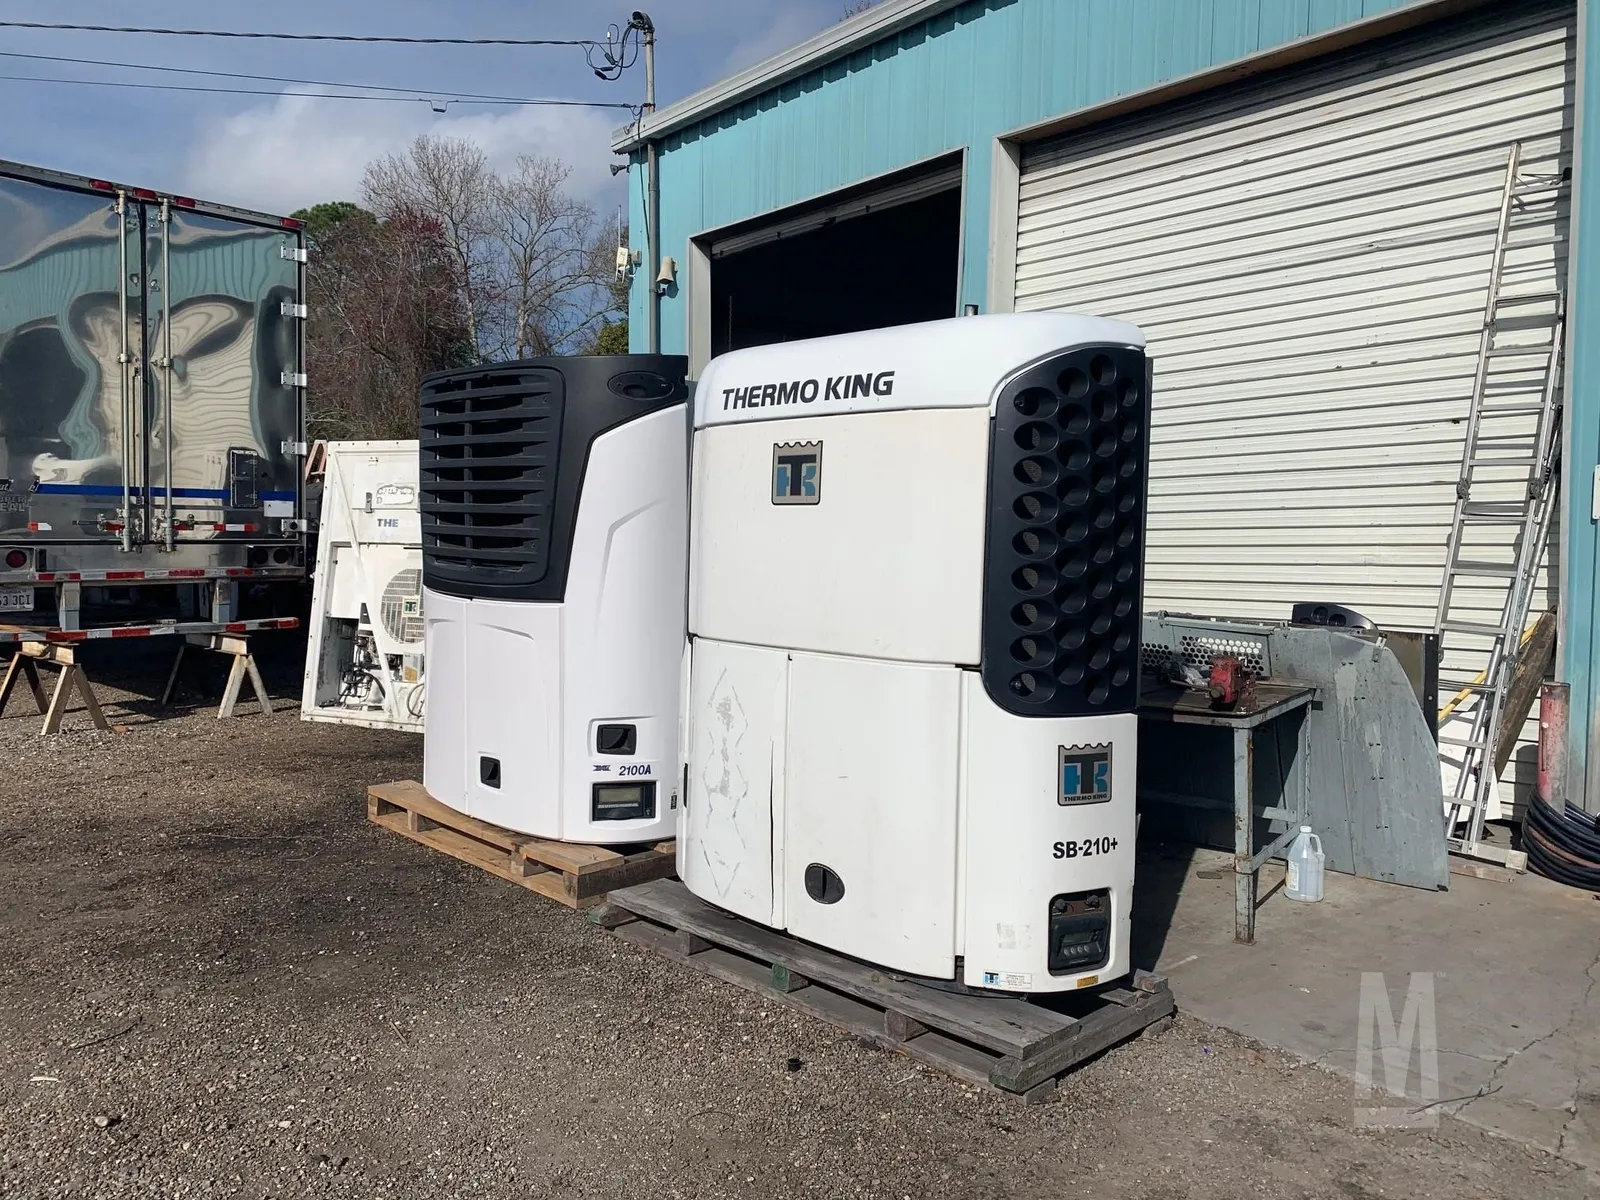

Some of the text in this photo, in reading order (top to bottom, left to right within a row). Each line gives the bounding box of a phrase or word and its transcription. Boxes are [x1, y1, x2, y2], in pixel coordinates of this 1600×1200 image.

[723, 371, 895, 410] THERMO KING
[0, 595, 9, 606] 3
[618, 764, 652, 776] 2100A
[1052, 836, 1118, 859] SB-210+
